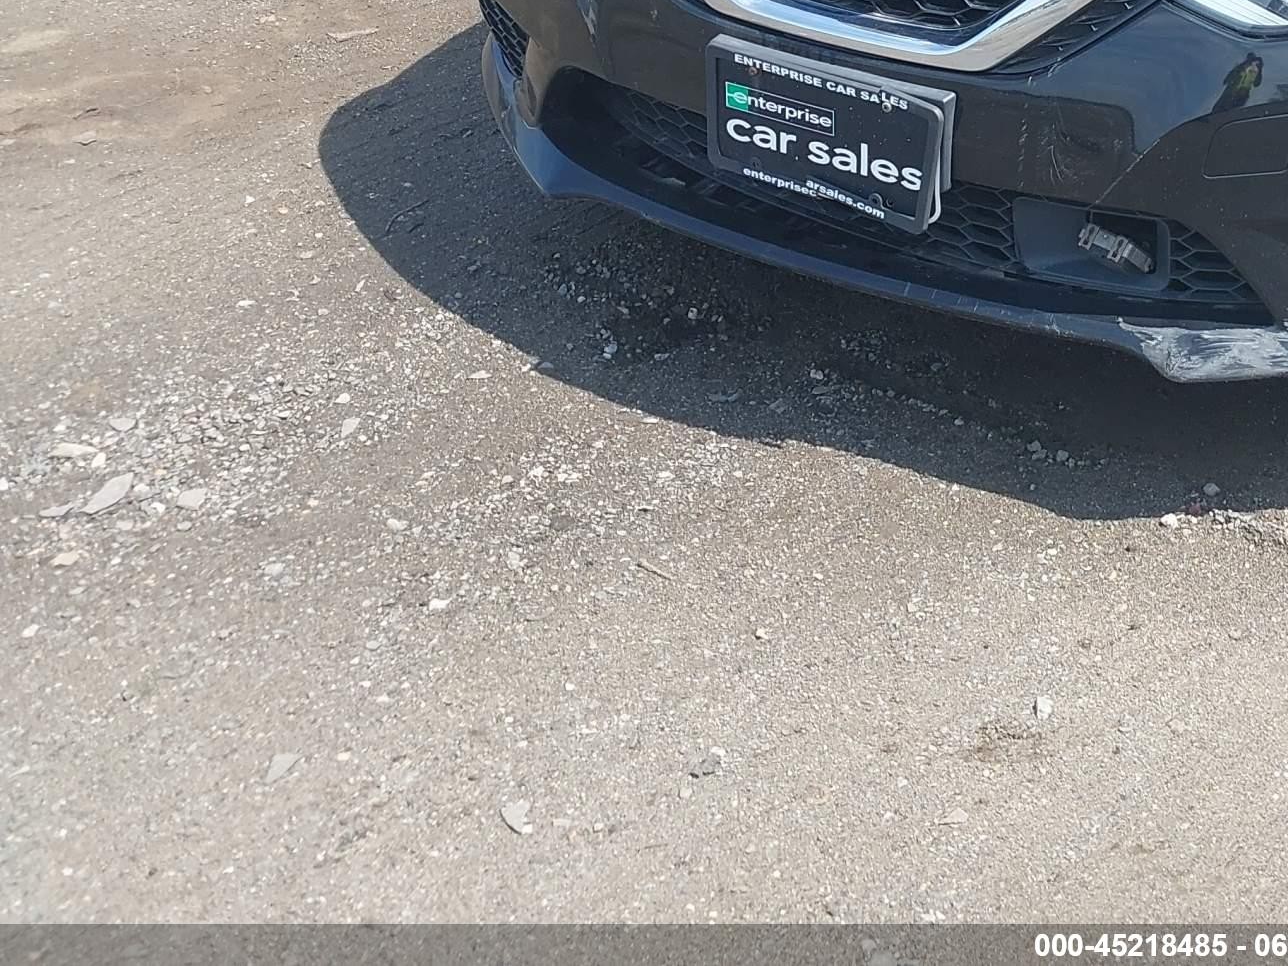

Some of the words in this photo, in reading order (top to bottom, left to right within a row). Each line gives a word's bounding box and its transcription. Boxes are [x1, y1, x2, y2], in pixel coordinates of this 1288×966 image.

[733, 91, 833, 128] enterprise
[734, 53, 823, 88] ENTERPRISE
[826, 81, 857, 98] CAR
[860, 91, 908, 110] SALES
[726, 118, 797, 155] car
[808, 140, 923, 191] sales
